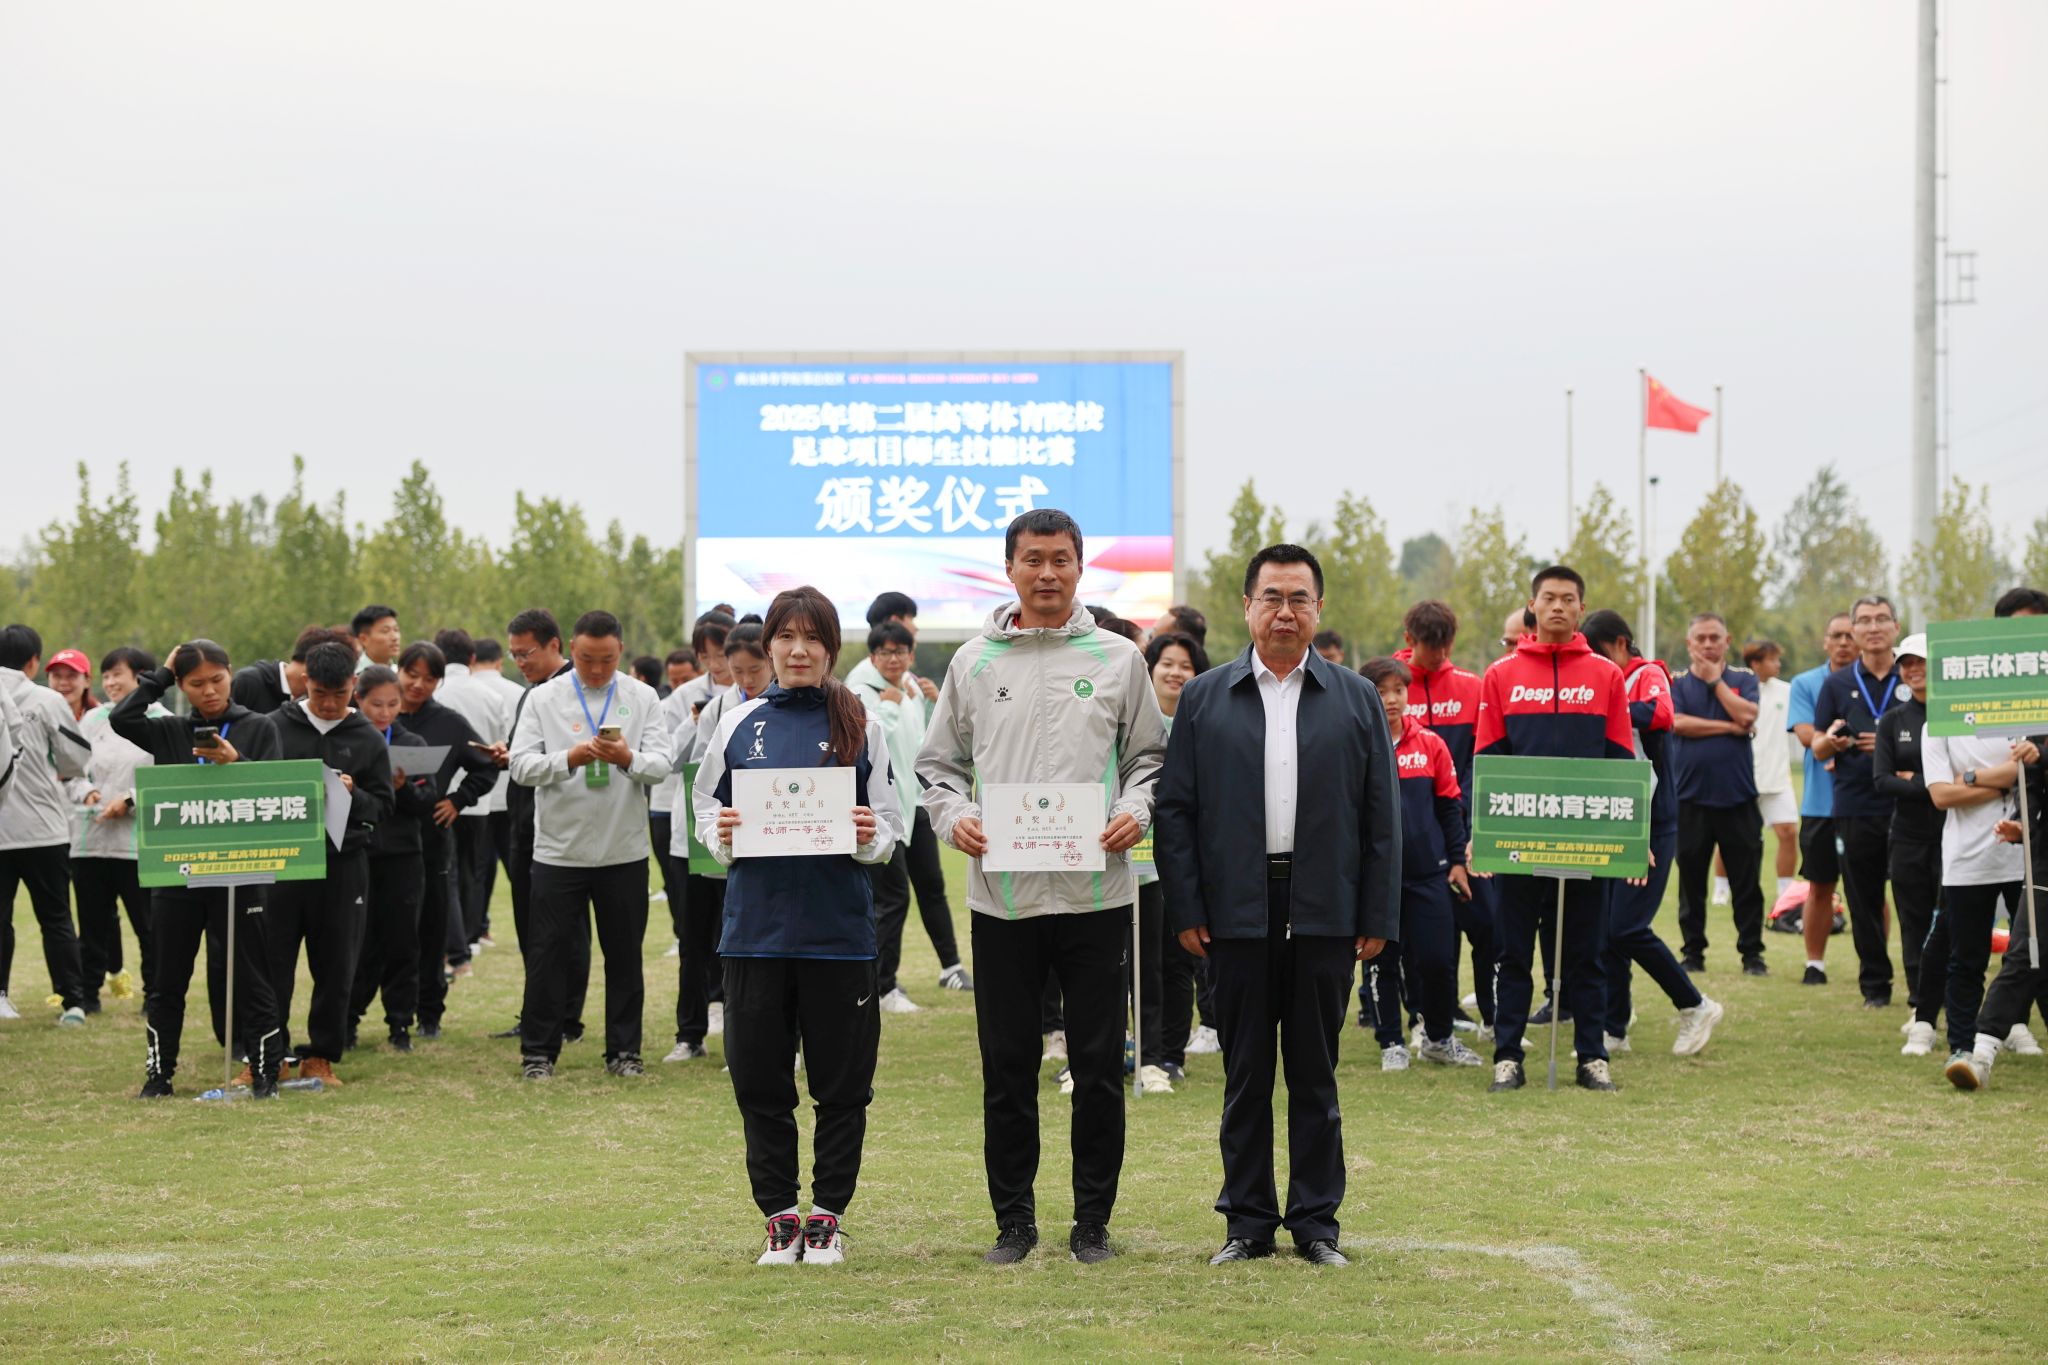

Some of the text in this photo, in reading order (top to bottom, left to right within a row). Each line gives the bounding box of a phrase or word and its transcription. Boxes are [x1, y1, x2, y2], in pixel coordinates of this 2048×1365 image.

[814, 475, 1050, 534] 颁奖仪式
[1403, 699, 1462, 718] esporte
[753, 721, 766, 736] 7
[154, 796, 307, 826] 广州体育学院
[765, 800, 824, 809] 获奖证书
[1489, 792, 1634, 821] 沈阳体育学院
[763, 825, 827, 835] 教师一等奖
[1012, 841, 1077, 850] 教师一等奖
